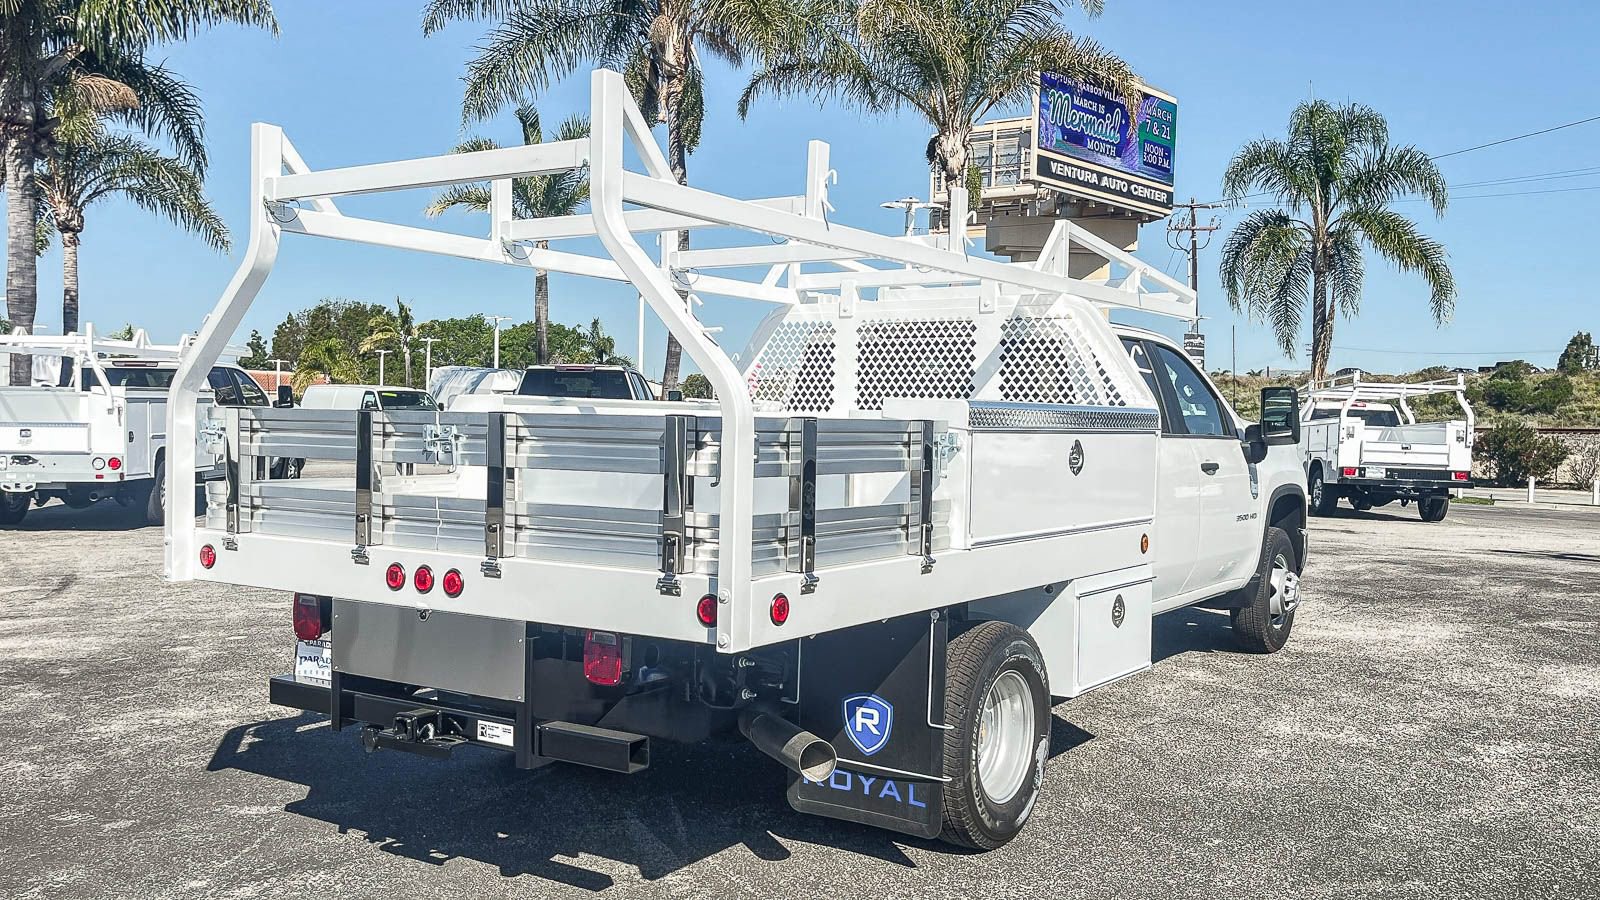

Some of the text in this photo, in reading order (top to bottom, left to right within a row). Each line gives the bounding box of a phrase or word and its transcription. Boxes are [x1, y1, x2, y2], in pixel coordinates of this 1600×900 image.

[1077, 81, 1102, 97] HARBOR
[1073, 95, 1105, 114] MARCH IS
[1146, 105, 1172, 122] MARCH
[1048, 89, 1121, 144] Mermaid
[1146, 119, 1171, 139] 7 & 21
[1087, 138, 1116, 157] MONTH
[1144, 143, 1164, 157] NOON
[1050, 161, 1167, 203] VENTURA AUTO CENTER
[1236, 512, 1257, 522] 3500 HD
[855, 706, 881, 736] R
[803, 769, 926, 808] OYAL
